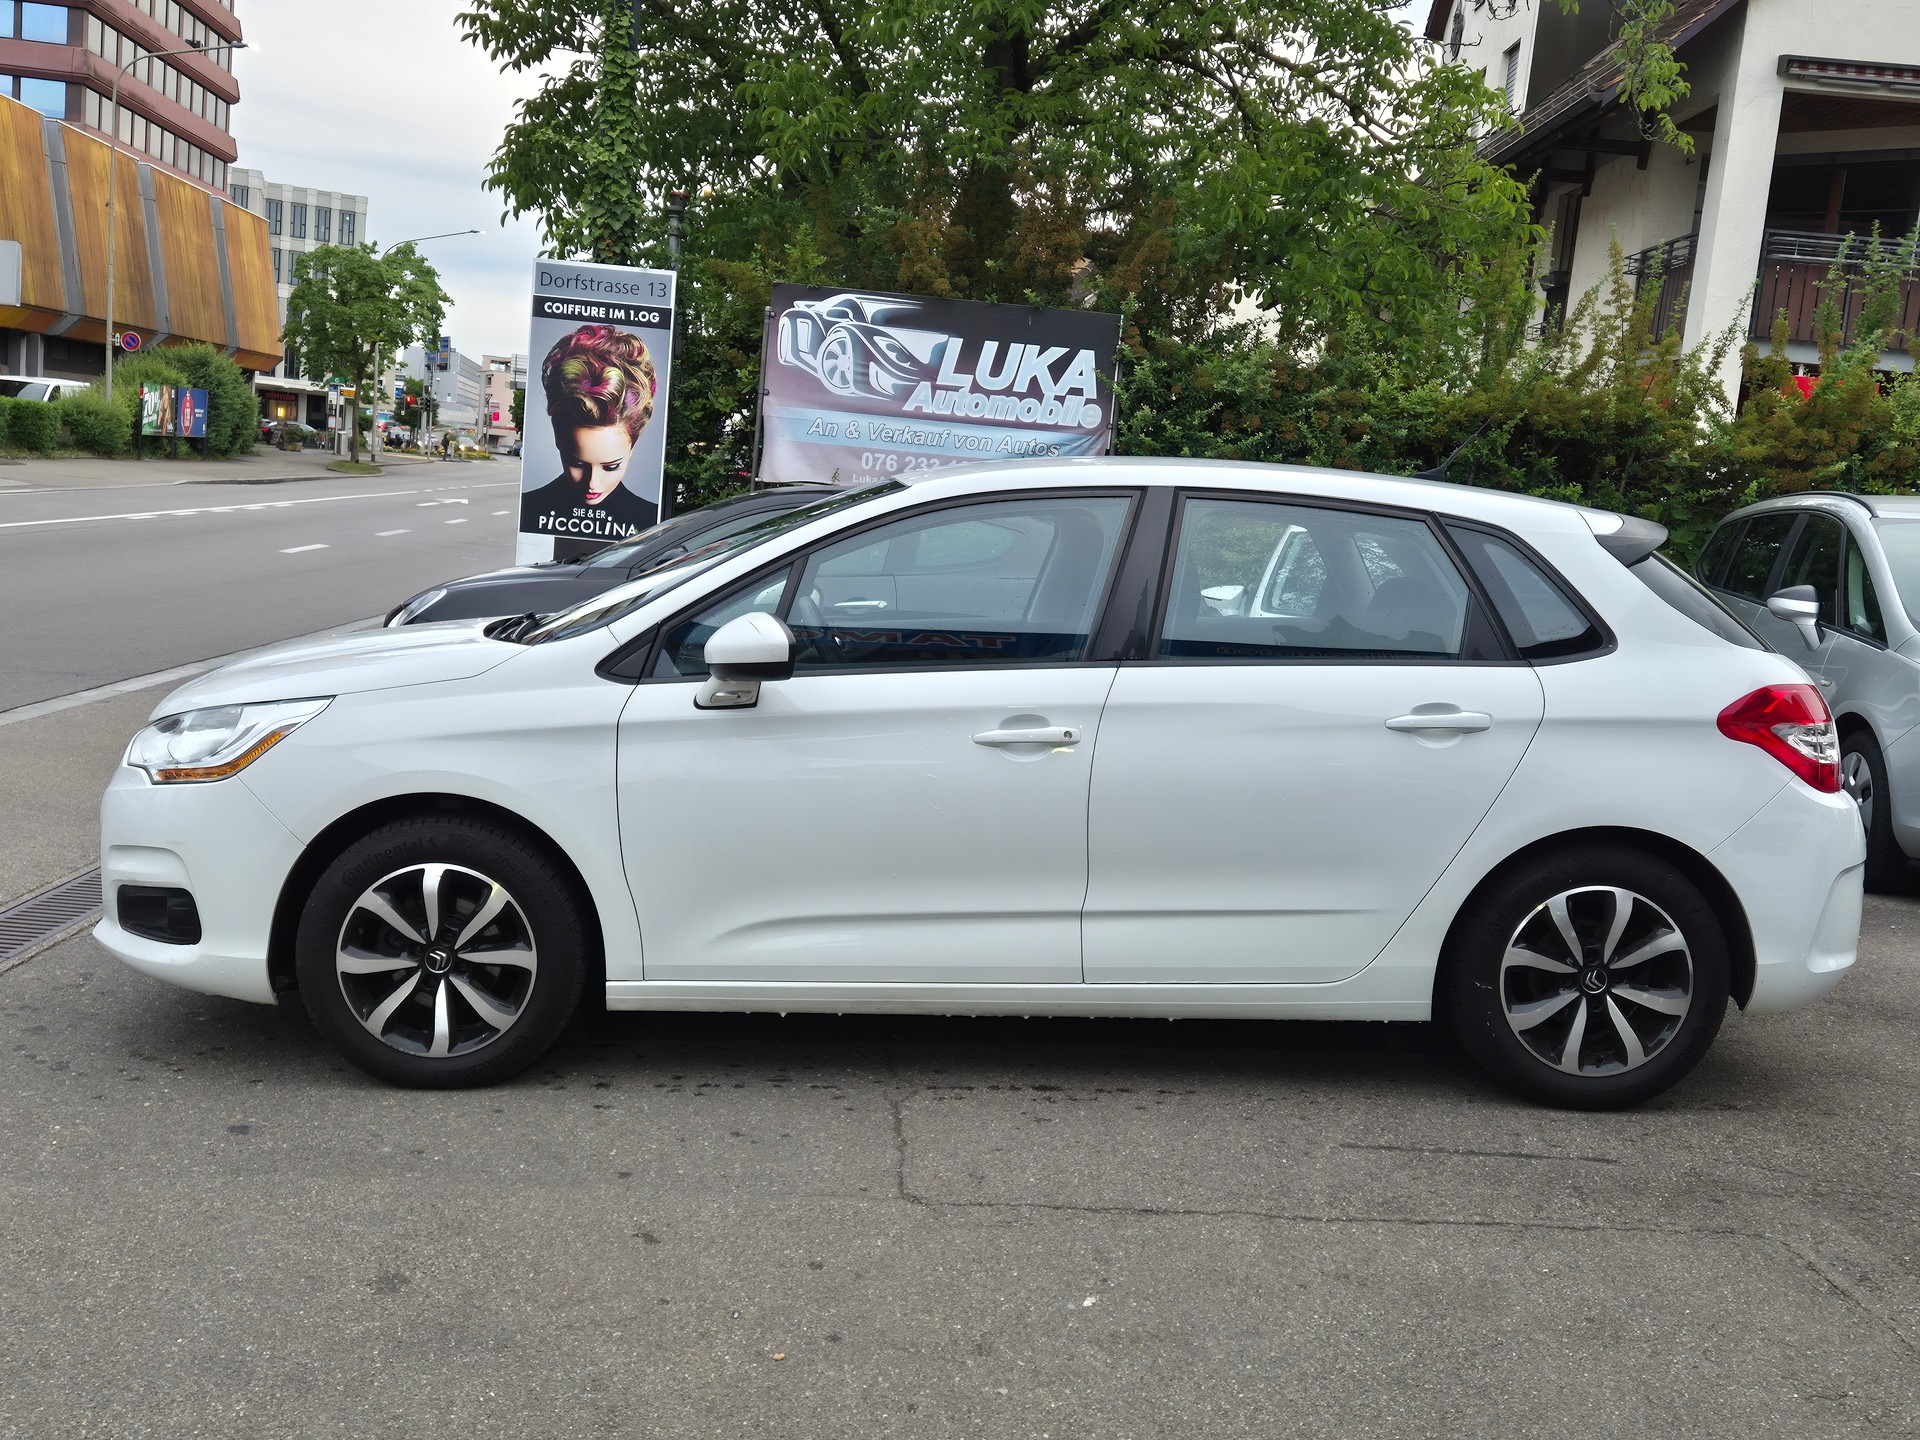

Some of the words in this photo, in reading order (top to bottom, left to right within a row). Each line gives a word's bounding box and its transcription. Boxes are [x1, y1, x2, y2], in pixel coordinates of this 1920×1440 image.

[540, 271, 640, 295] Dorfstrasse
[648, 282, 667, 298] 13
[543, 301, 606, 318] COIFFURE
[609, 308, 625, 320] IM
[629, 310, 660, 323] 1.OG
[936, 336, 1098, 400] LUKA
[902, 381, 1102, 429] Automobile
[807, 417, 839, 437] An
[844, 420, 861, 439] &
[868, 422, 951, 447] Verkauf
[953, 434, 994, 451] von
[995, 436, 1061, 458] Autos
[861, 451, 898, 472] 076
[572, 508, 586, 517] SIE
[587, 509, 594, 518] &
[595, 510, 606, 519] ER
